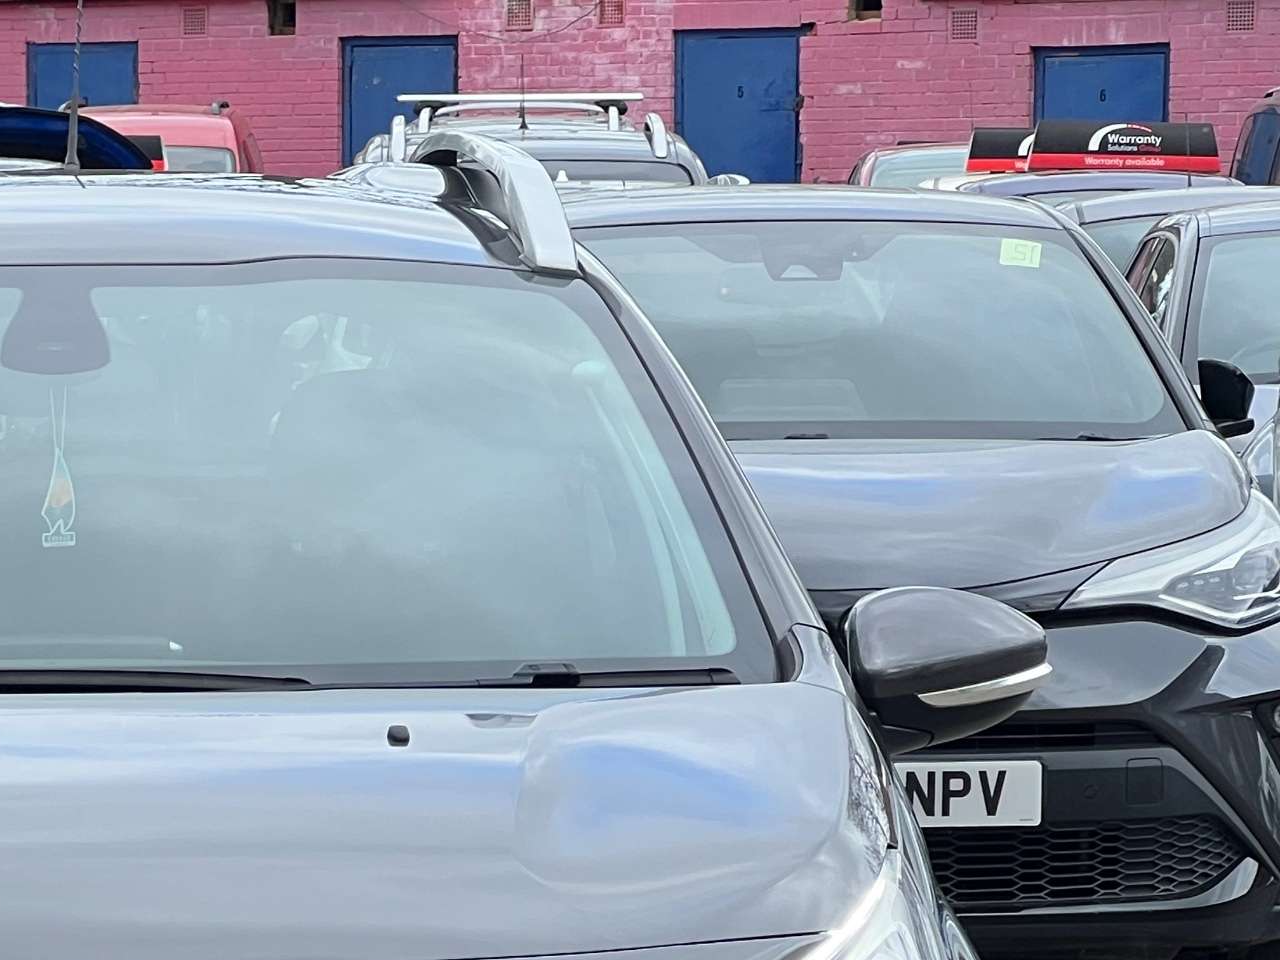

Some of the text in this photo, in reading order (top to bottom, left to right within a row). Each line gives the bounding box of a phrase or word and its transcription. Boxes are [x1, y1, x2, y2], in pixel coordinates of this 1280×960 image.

[738, 86, 744, 98] 5
[1100, 89, 1106, 102] 6
[1107, 133, 1162, 147] Warranty
[1084, 157, 1165, 168] Warranty available
[905, 769, 1007, 817] NPV
